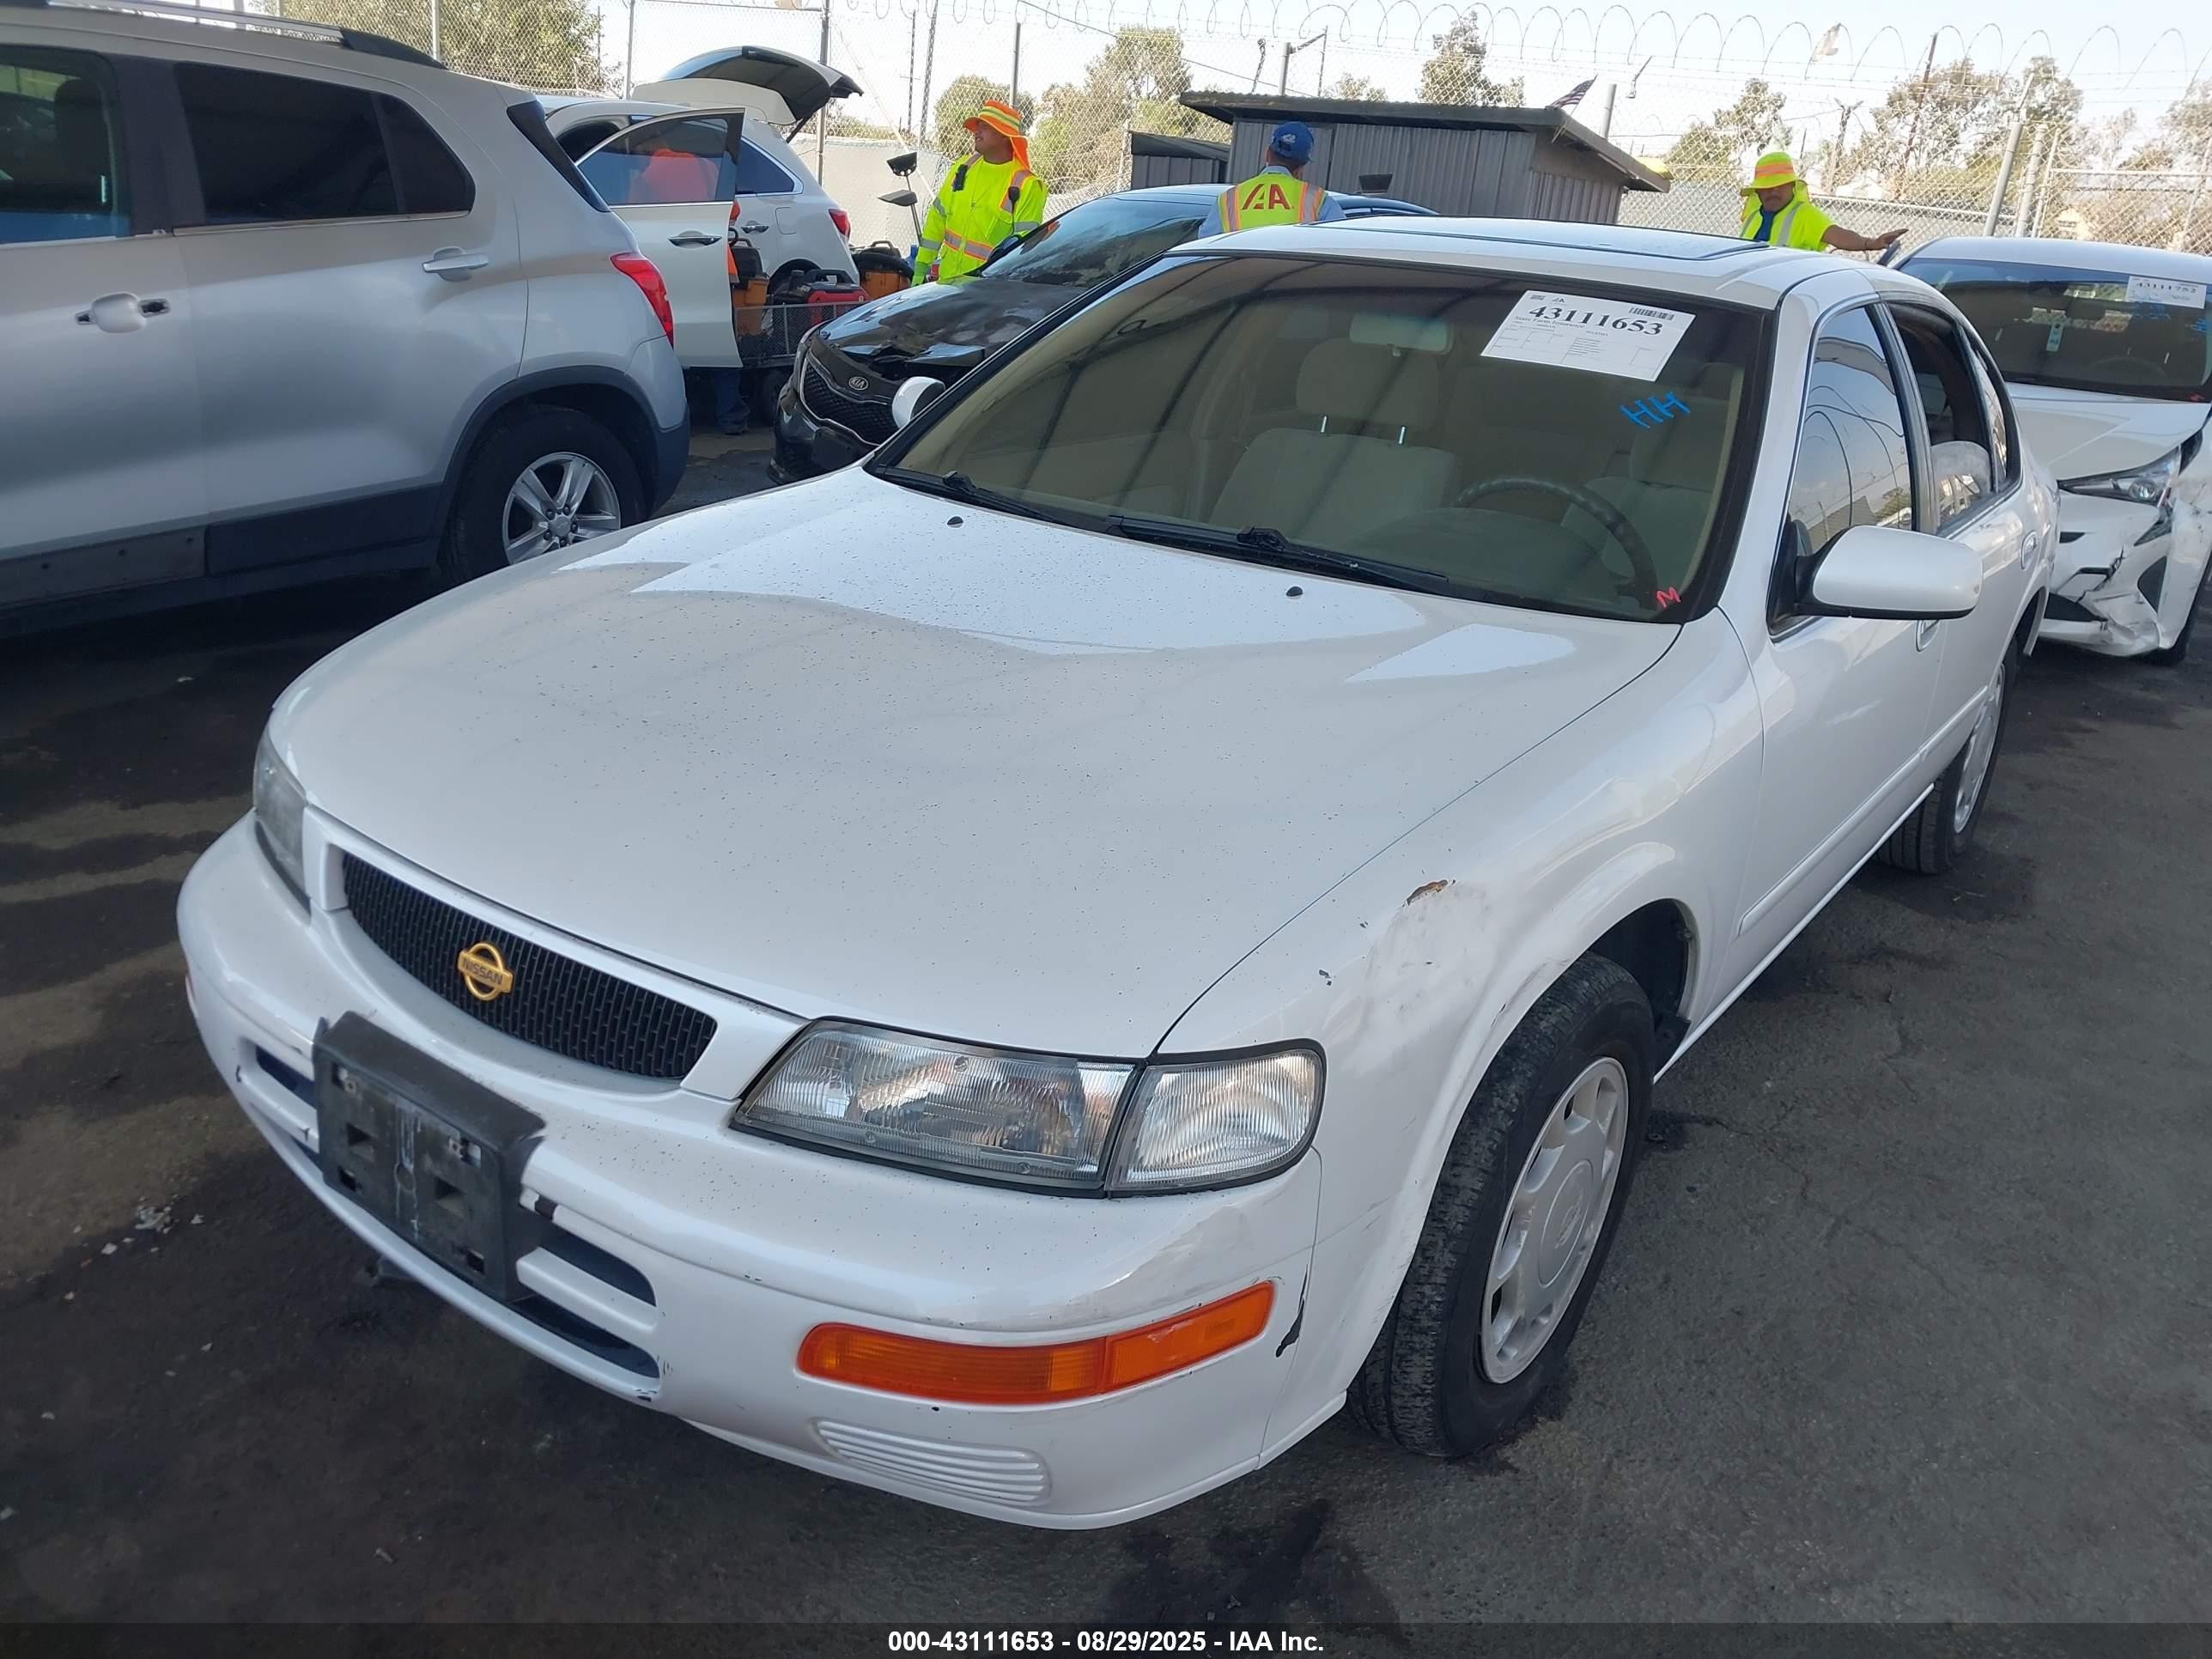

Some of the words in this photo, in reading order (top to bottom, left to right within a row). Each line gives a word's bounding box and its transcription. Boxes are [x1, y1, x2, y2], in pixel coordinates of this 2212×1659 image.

[1528, 305, 1663, 336] 43111653
[850, 377, 866, 389] KIA
[465, 957, 503, 985] NISSAN
